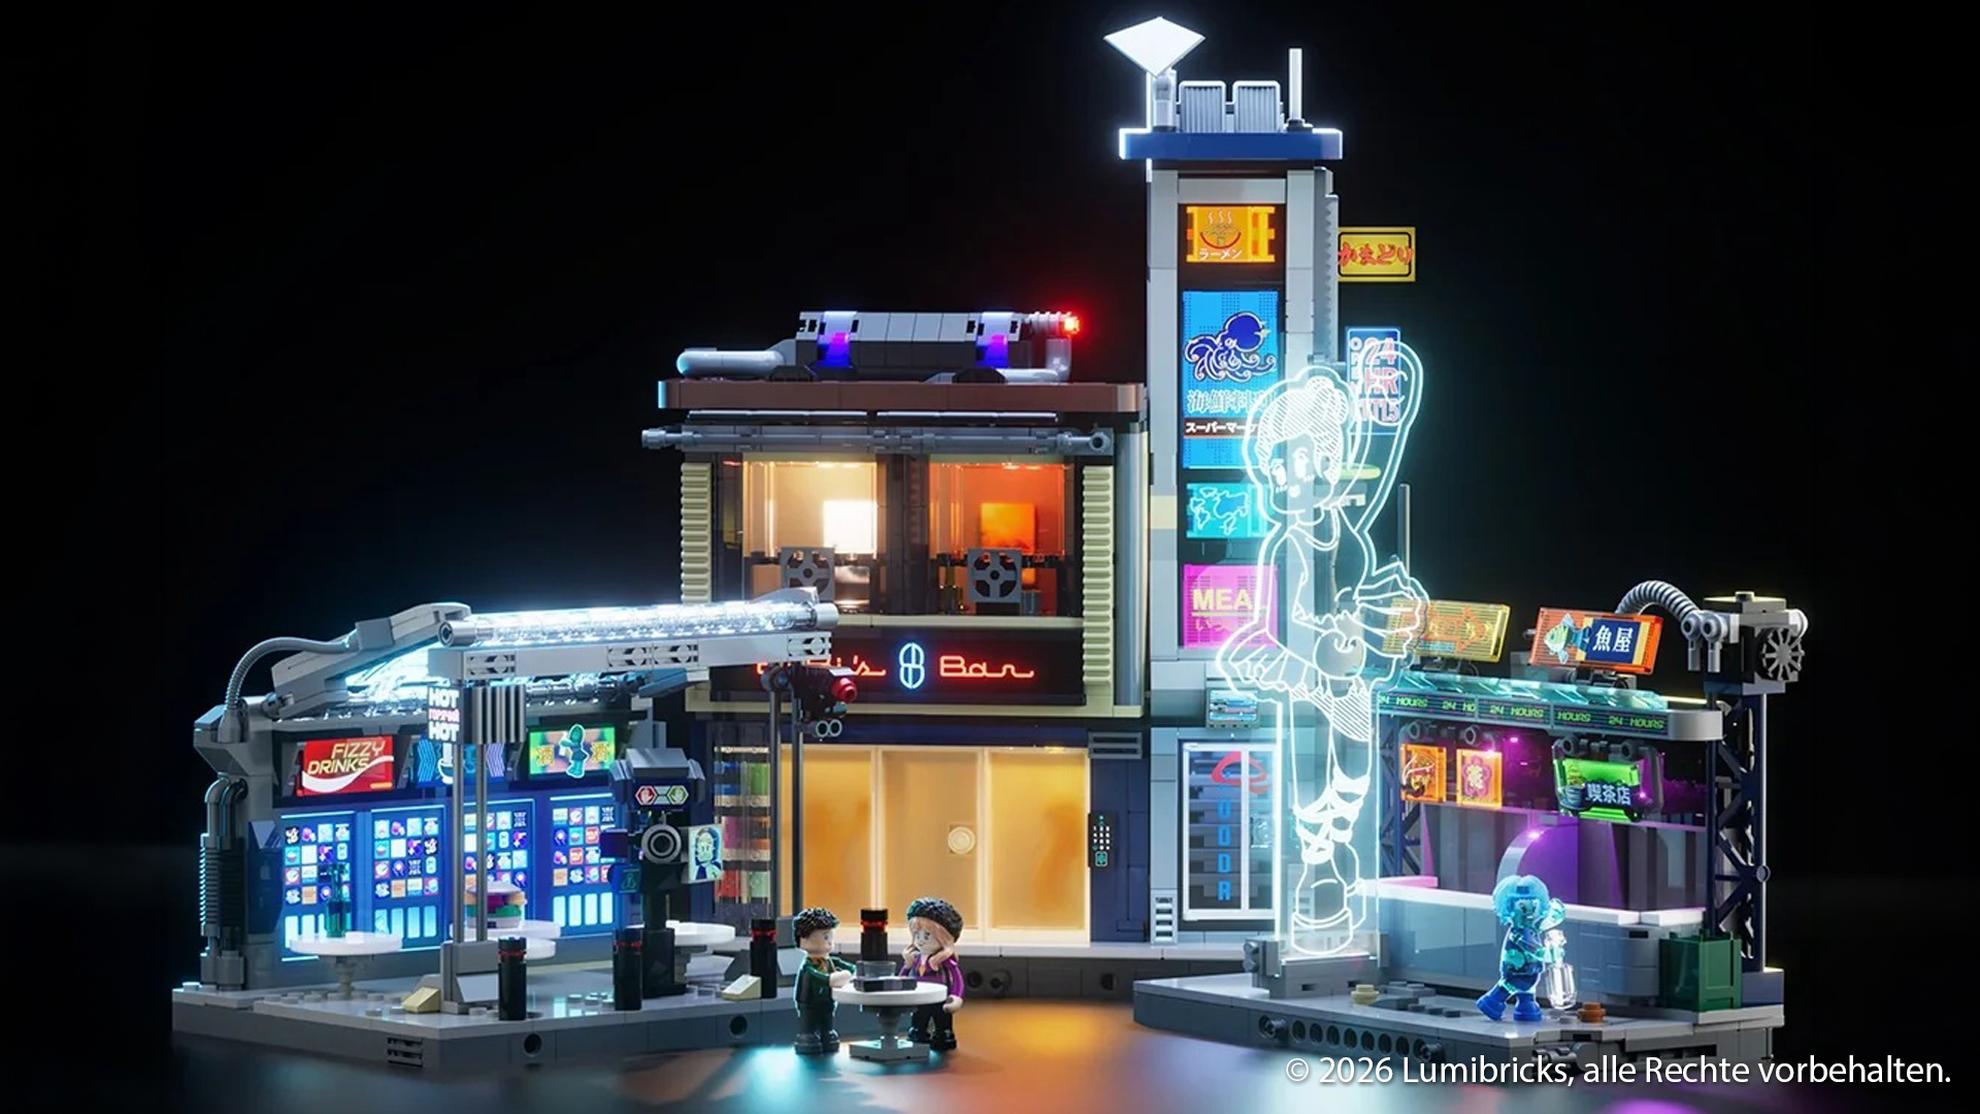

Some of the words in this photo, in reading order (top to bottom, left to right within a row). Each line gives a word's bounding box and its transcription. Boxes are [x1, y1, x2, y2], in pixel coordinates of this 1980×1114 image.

[1199, 247, 1242, 261] ラーメン
[1193, 589, 1254, 610] MEA
[1592, 624, 1634, 652] 魚屋
[940, 656, 1035, 677] Bar
[429, 687, 460, 708] HOT
[1396, 696, 1428, 708] HOURS
[1442, 701, 1457, 711] 24
[1490, 705, 1504, 715] 24
[1511, 706, 1544, 719] HOURS
[1557, 711, 1591, 723] HOURS
[1608, 715, 1623, 726] 24
[1630, 718, 1665, 730] HOURS
[429, 721, 460, 742] HOT
[331, 741, 386, 759] FIZZY
[307, 757, 370, 775] DRINKS
